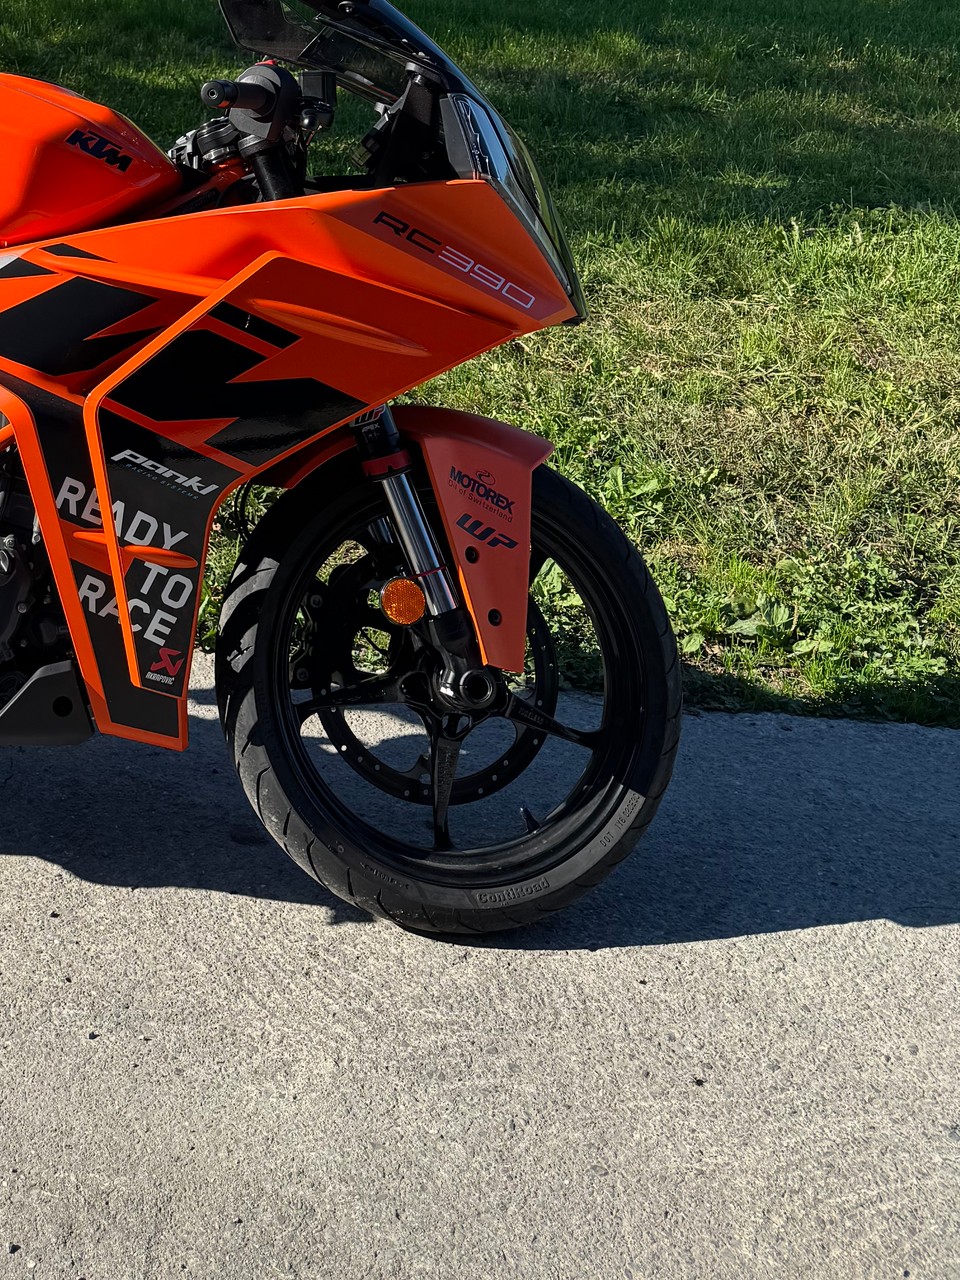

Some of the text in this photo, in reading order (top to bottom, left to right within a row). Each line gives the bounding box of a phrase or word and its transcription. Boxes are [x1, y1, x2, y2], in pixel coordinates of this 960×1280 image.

[65, 129, 133, 173] KTM
[126, 463, 199, 500] RACING SYSTEMS
[450, 465, 516, 515] MOTOREX
[55, 476, 189, 550] READY
[468, 492, 513, 523] Switzerland
[455, 512, 520, 550] WP
[140, 561, 193, 609] TO
